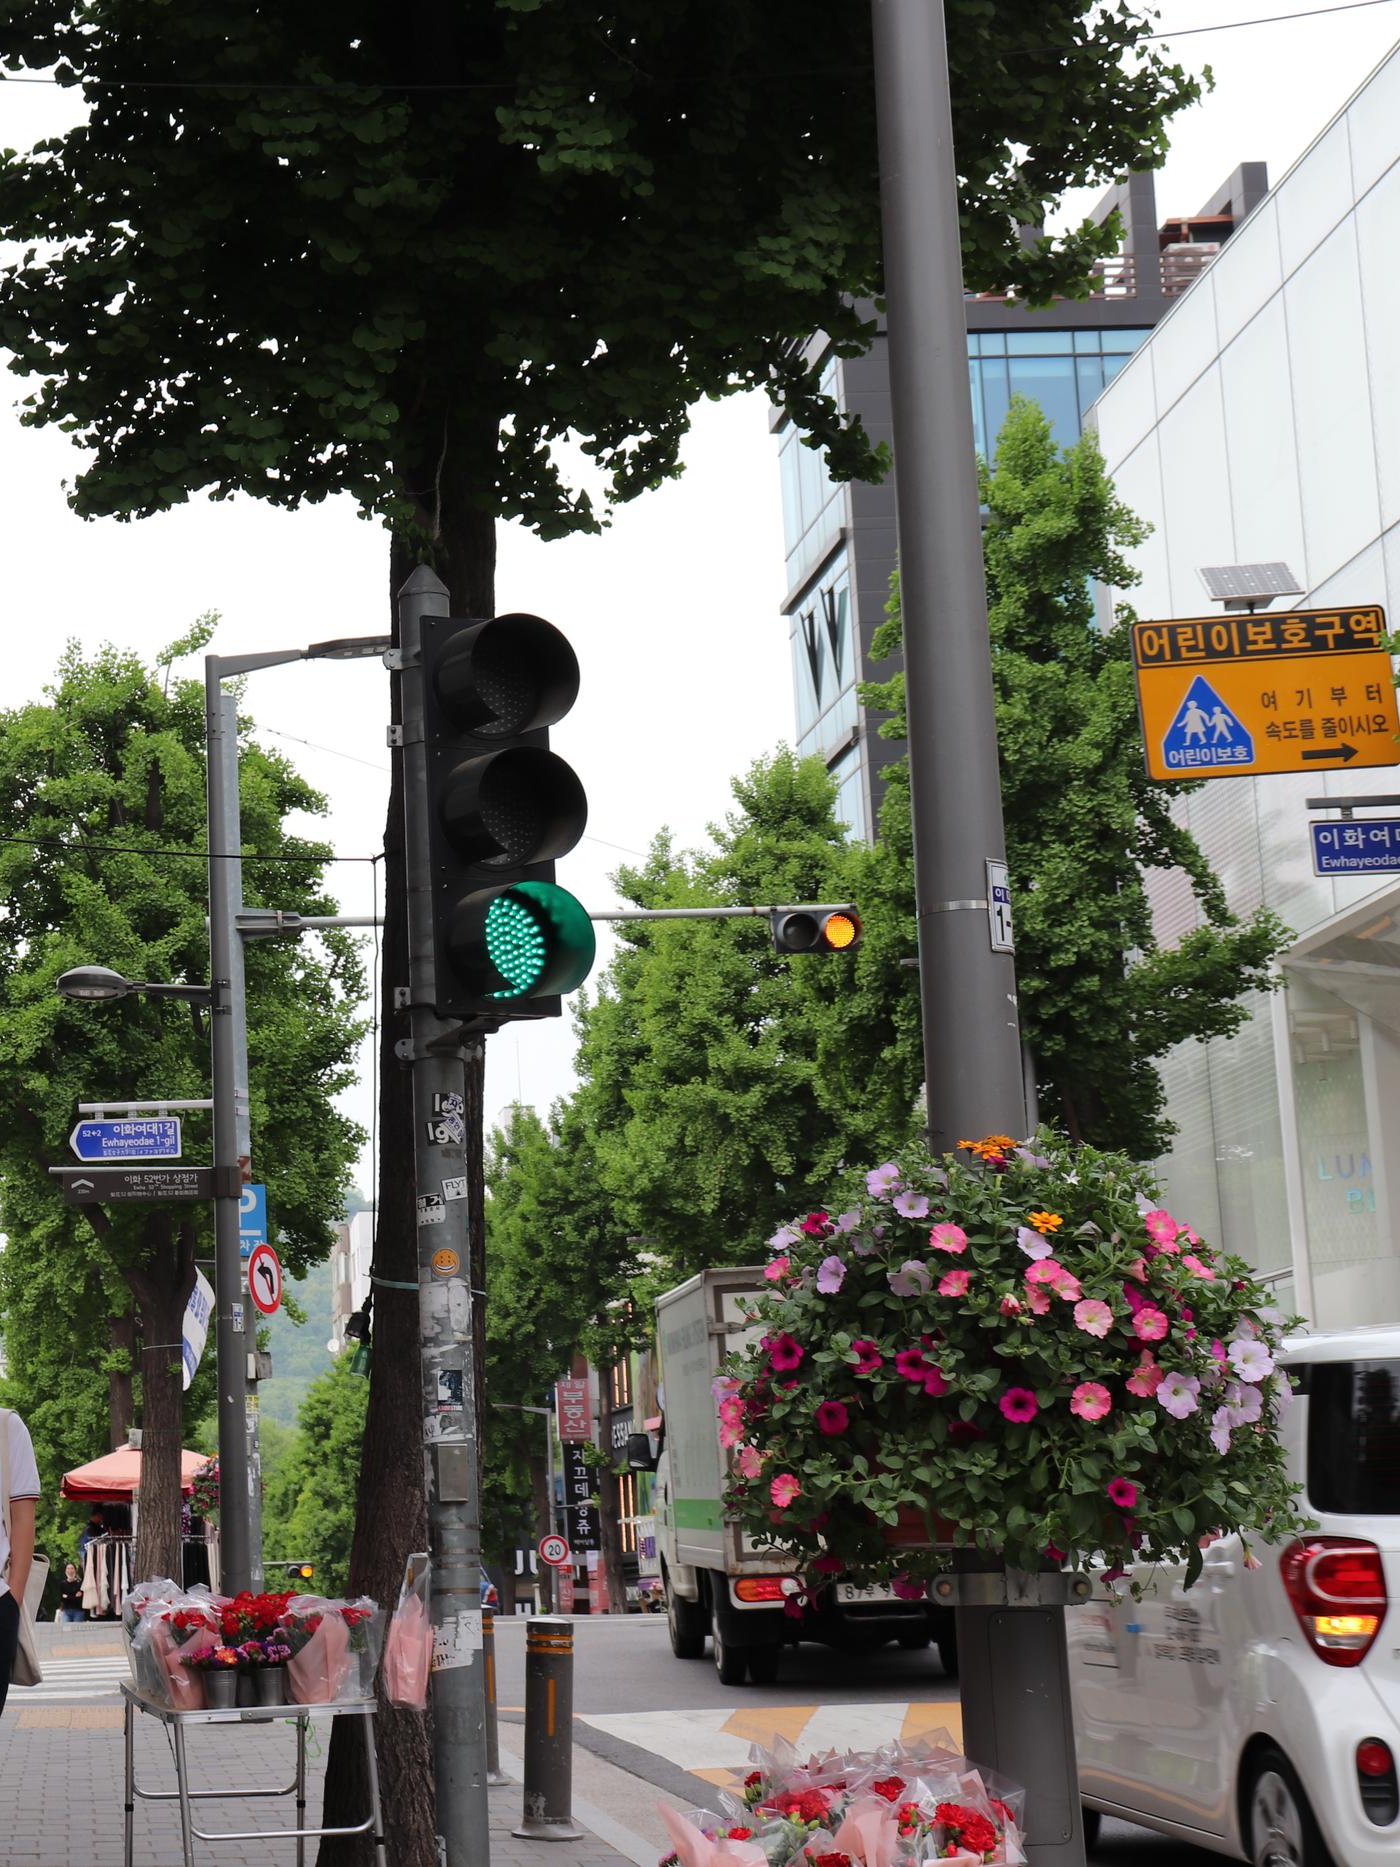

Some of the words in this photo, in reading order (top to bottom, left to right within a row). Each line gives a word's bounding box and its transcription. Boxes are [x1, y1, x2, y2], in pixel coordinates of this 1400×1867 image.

[1141, 611, 1382, 661] 어린이보호구역
[1265, 719, 1316, 742] 속도를
[1320, 713, 1390, 740] 줄이시오
[1168, 745, 1250, 766] 어린이보호
[102, 1136, 155, 1148] Ewhayeodae
[156, 1135, 175, 1147] 1-gil
[563, 1391, 587, 1433] 부동산
[548, 1544, 561, 1556] 20
